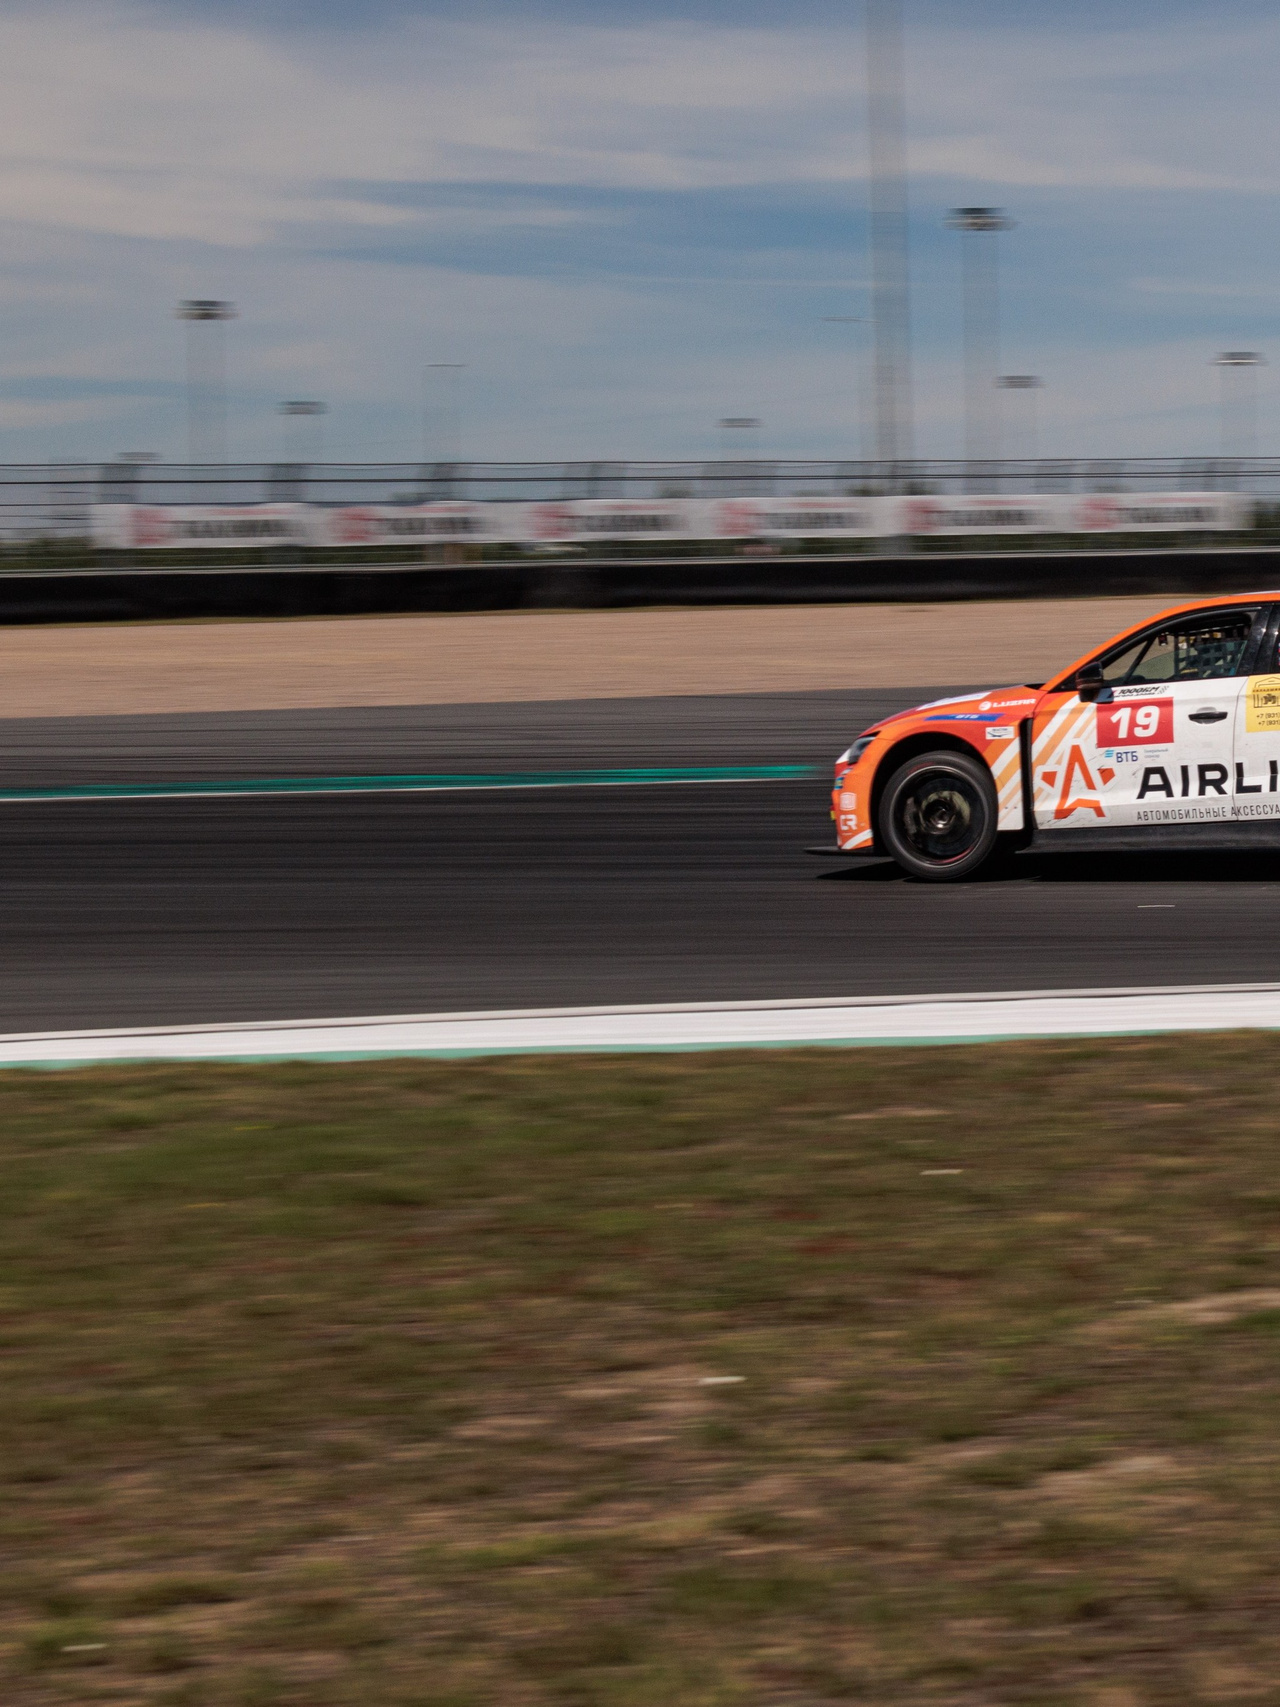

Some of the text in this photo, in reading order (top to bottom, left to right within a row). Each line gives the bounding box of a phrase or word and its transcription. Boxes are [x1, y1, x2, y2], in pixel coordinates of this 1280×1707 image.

[1110, 705, 1161, 739] 19
[1115, 750, 1139, 763] ВТБ
[1136, 806, 1227, 822] АВТОМОБИЛЬНЫЕ
